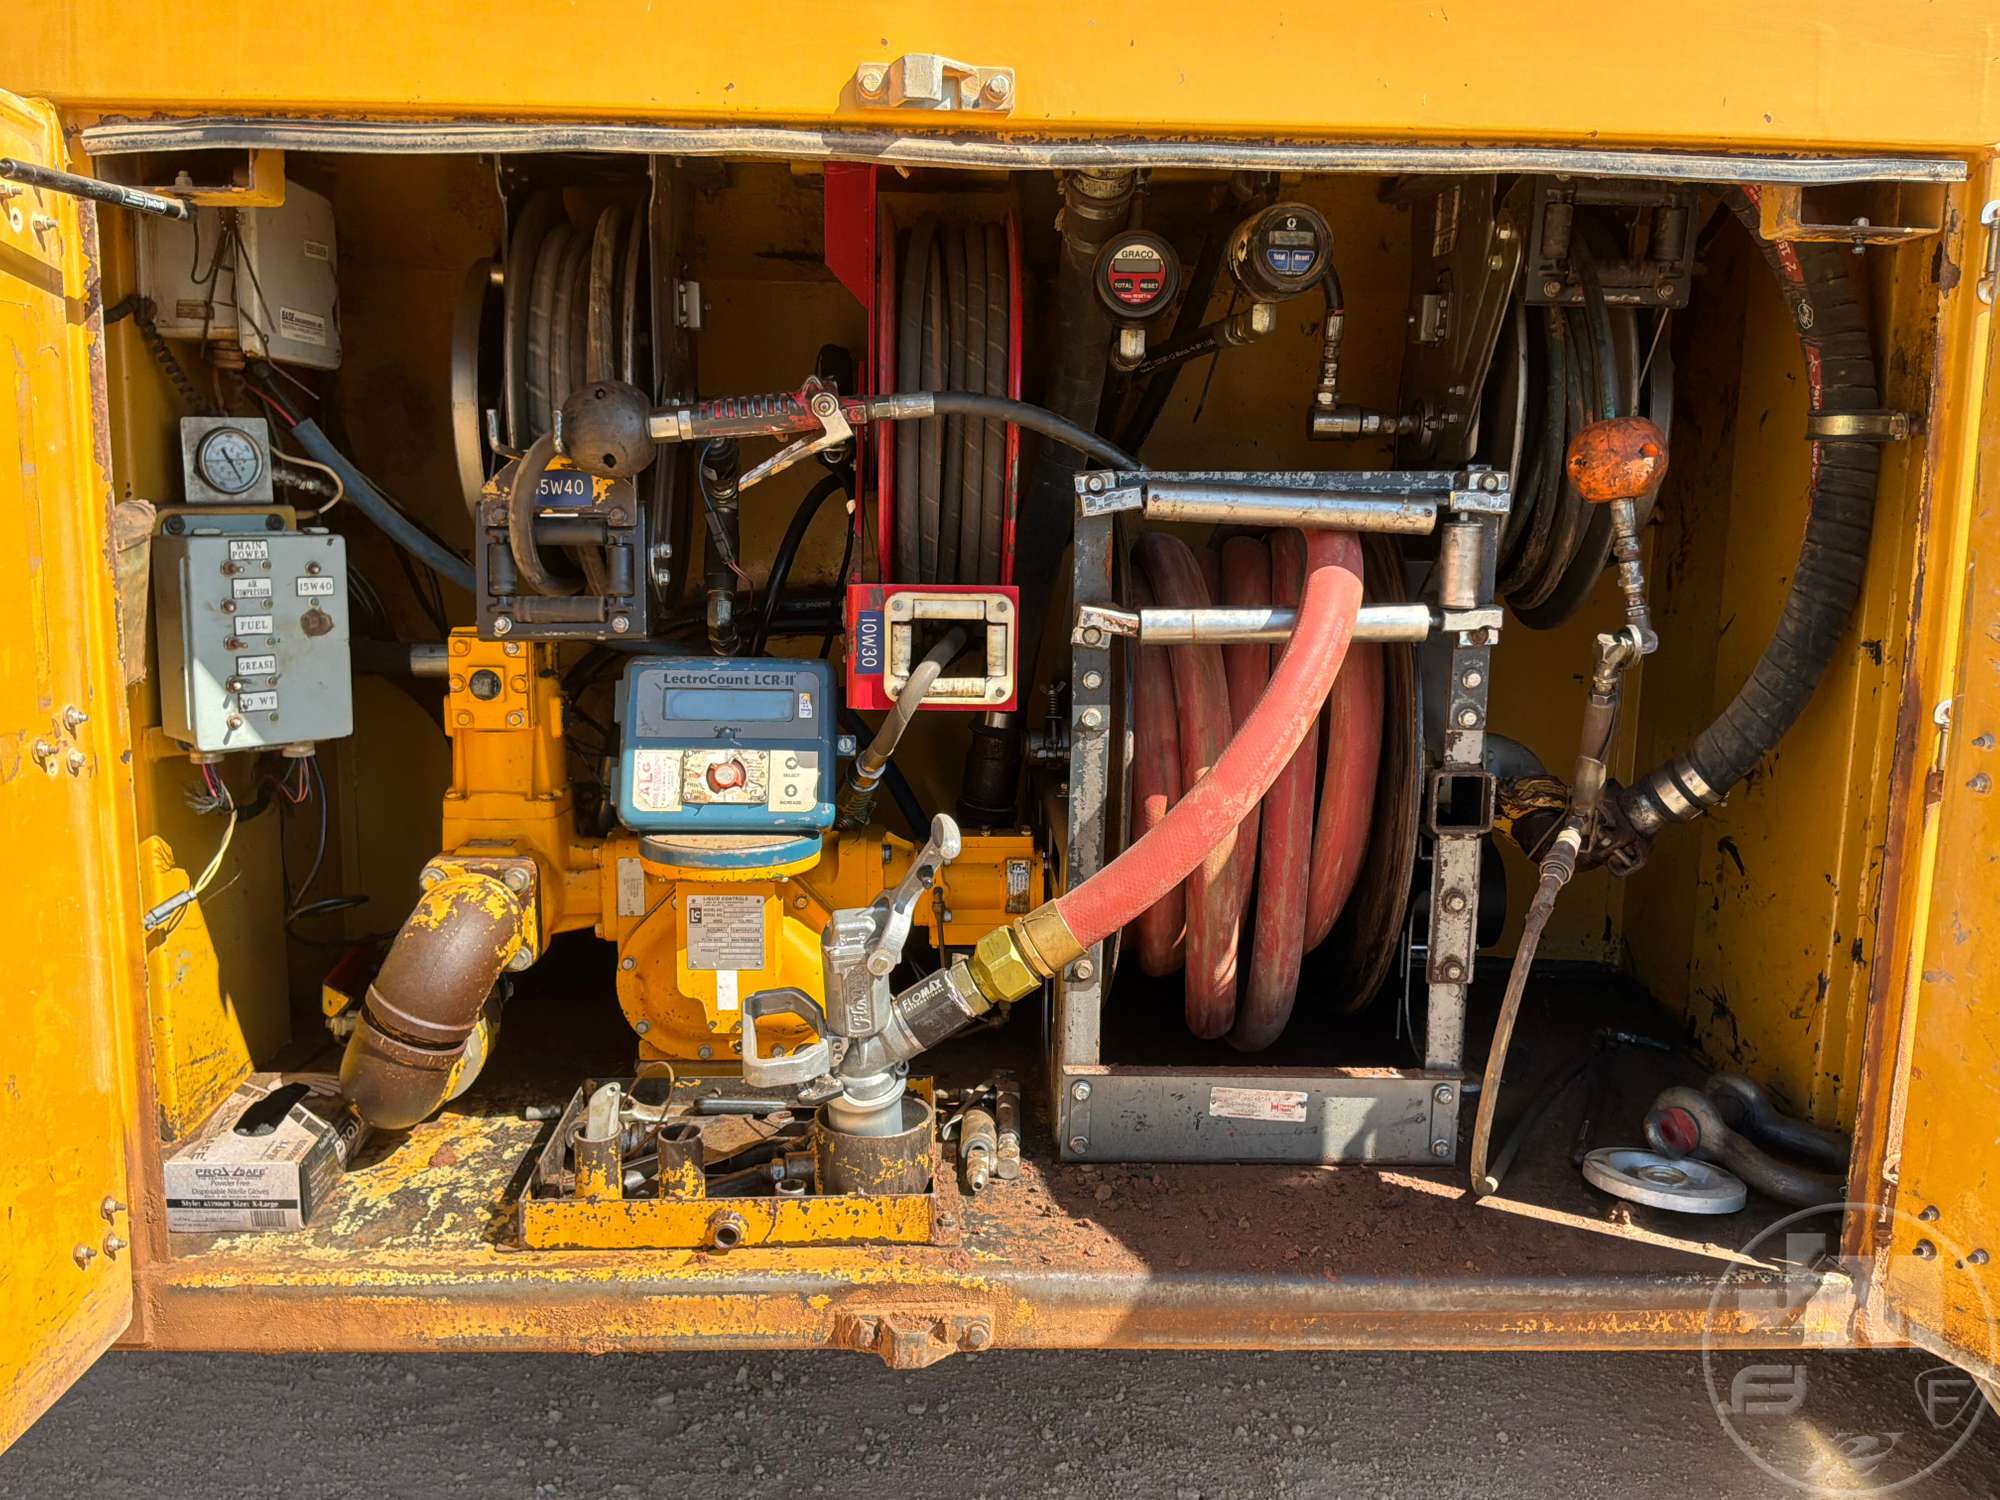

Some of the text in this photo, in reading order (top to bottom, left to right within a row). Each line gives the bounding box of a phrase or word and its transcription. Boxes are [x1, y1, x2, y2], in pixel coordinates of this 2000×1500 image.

[1121, 250, 1154, 258] GRACO
[236, 541, 262, 550] MAIN
[232, 550, 267, 559] POWER
[235, 587, 270, 597] COMPRESSOR
[300, 582, 332, 592] 15W40
[240, 621, 268, 631] FUEL
[861, 618, 877, 667] 10W30
[239, 660, 275, 671] GREASE
[663, 673, 749, 685] LectroCount
[259, 695, 275, 705] WT
[901, 978, 943, 1008] FLOMAX
[191, 1188, 226, 1196] Disposable
[248, 1188, 270, 1196] Gloves
[252, 1200, 279, 1208] X-Large
